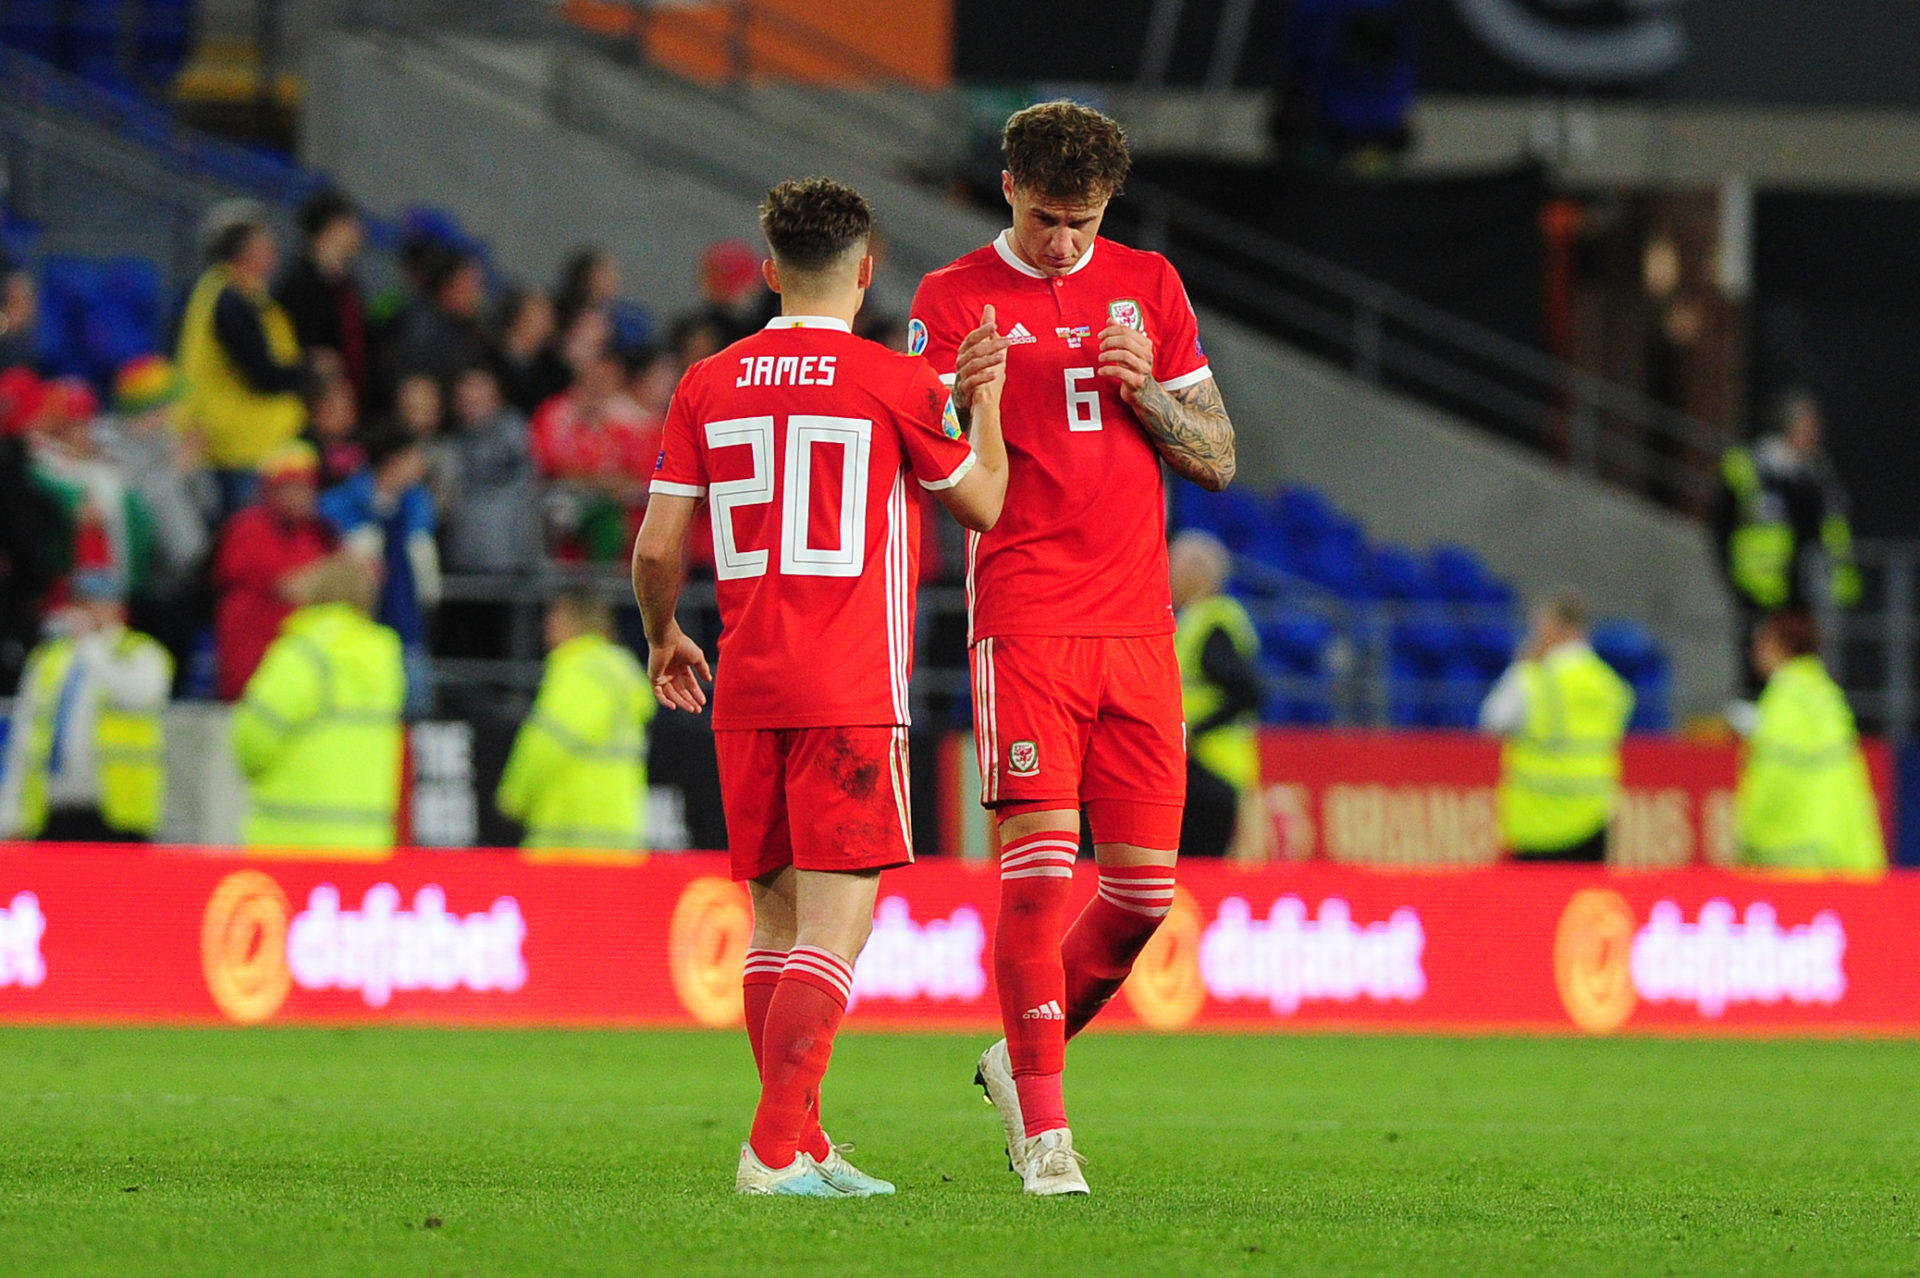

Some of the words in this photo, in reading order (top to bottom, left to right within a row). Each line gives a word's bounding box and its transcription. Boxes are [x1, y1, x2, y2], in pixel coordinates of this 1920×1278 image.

[735, 356, 837, 388] JAMES
[1064, 367, 1103, 432] 6
[704, 415, 873, 581] 20
[1022, 1012, 1065, 1021] adidas
